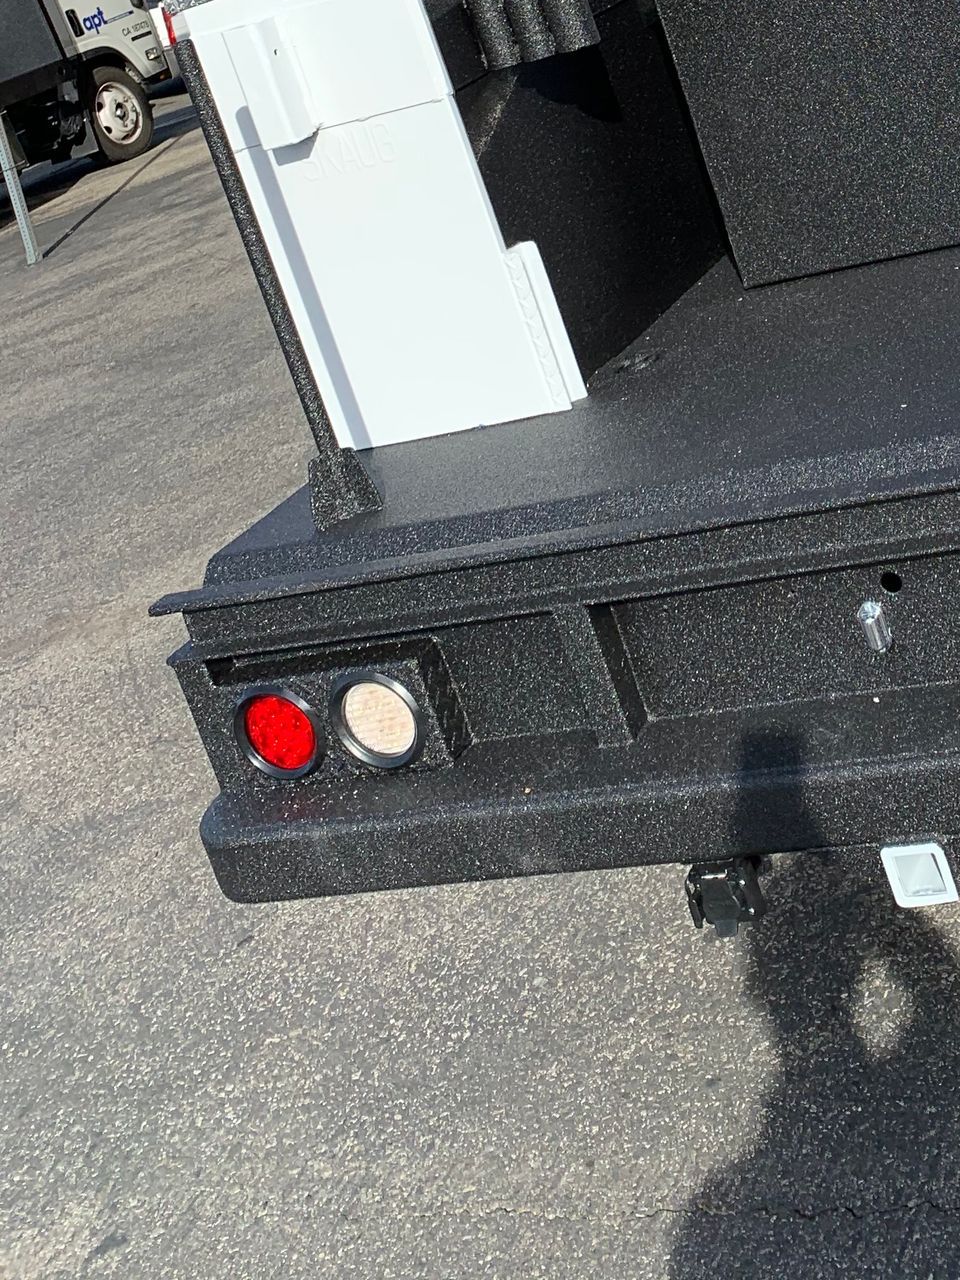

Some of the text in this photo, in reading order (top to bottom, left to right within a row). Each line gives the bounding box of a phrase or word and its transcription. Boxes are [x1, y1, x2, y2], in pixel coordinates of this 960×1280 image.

[82, 6, 108, 35] apt
[121, 27, 132, 37] CA
[303, 122, 397, 184] SKAUG
